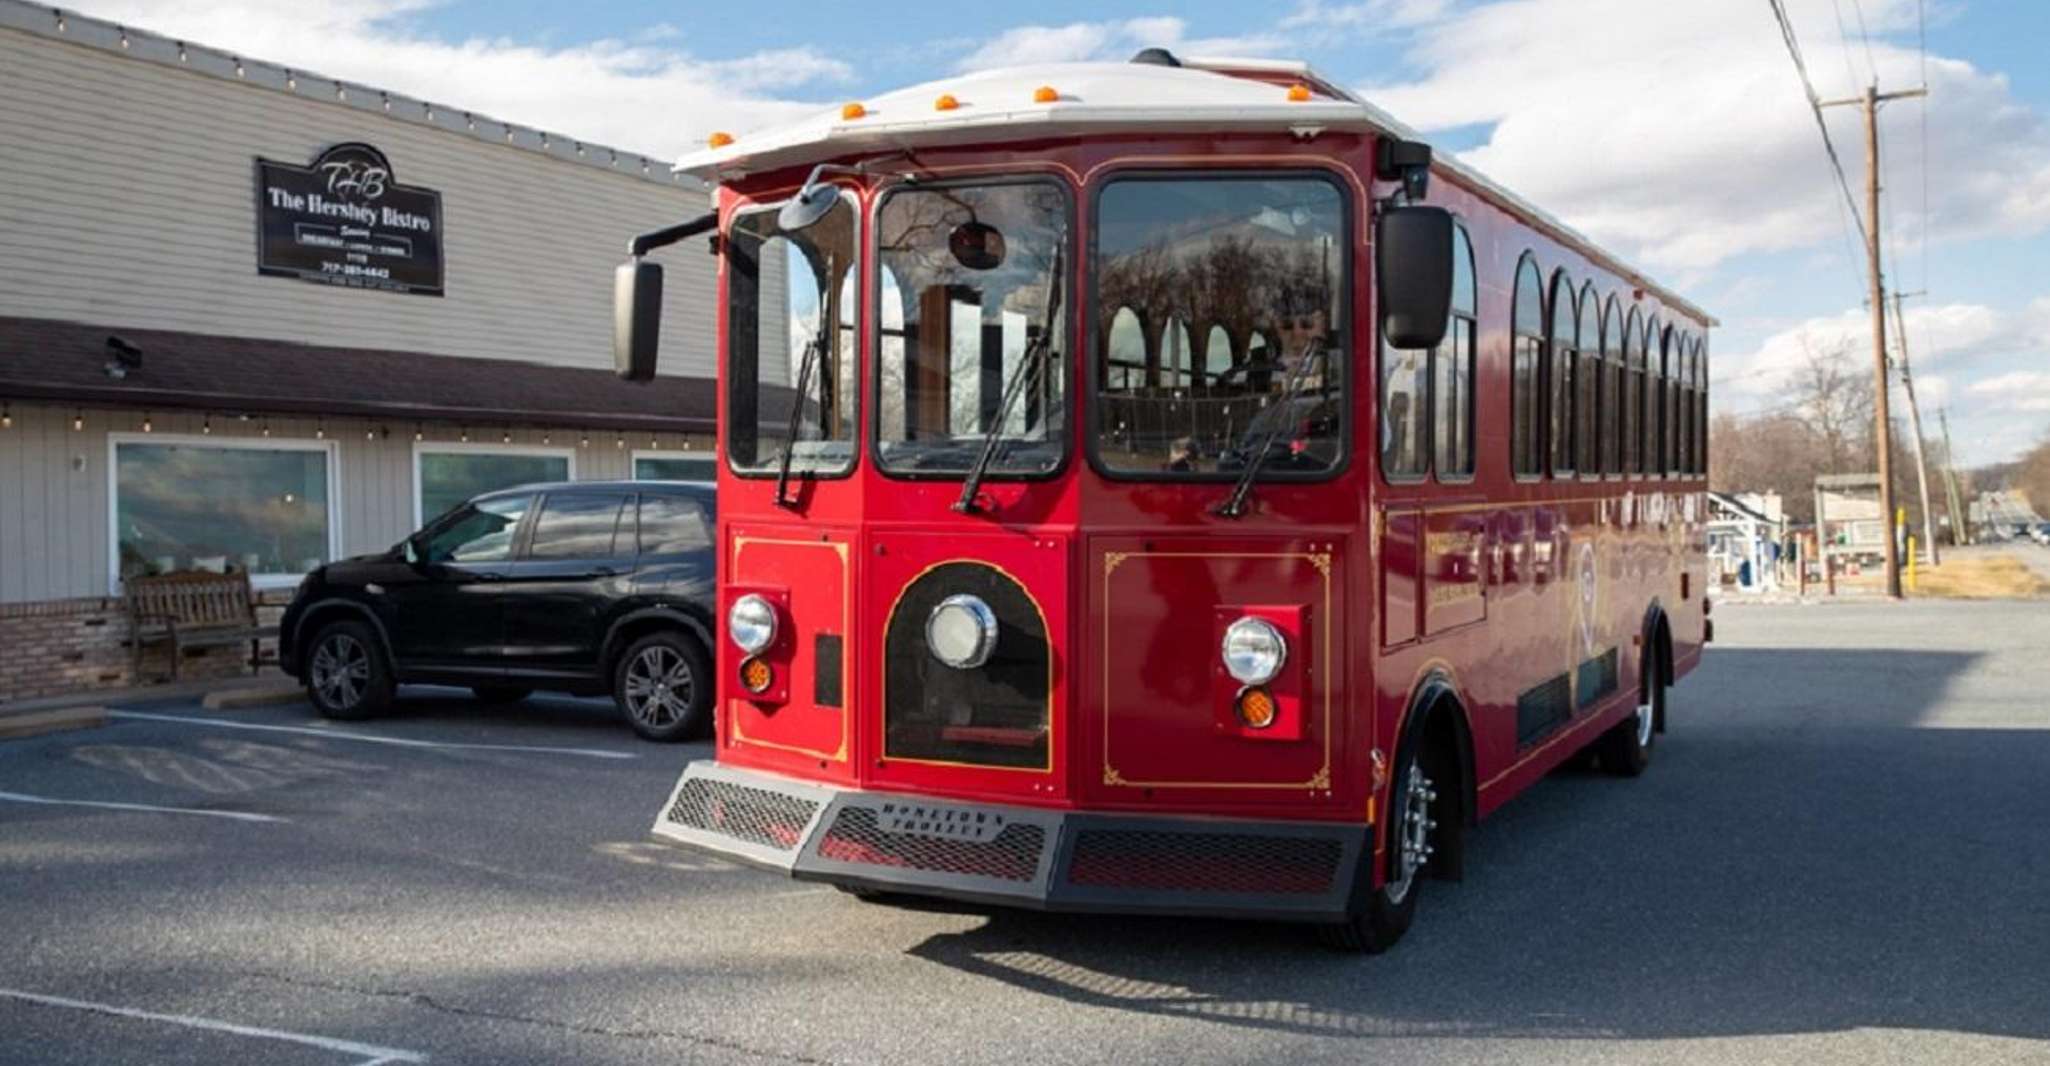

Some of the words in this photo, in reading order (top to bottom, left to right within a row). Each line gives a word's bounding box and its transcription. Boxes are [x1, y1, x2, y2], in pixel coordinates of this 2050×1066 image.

[321, 161, 387, 199] THB
[268, 187, 305, 210] The
[308, 193, 377, 226] Hershey
[381, 206, 431, 232] Bistro
[882, 803, 1004, 826] HOMETOWN
[892, 818, 984, 838] TROLLEY
